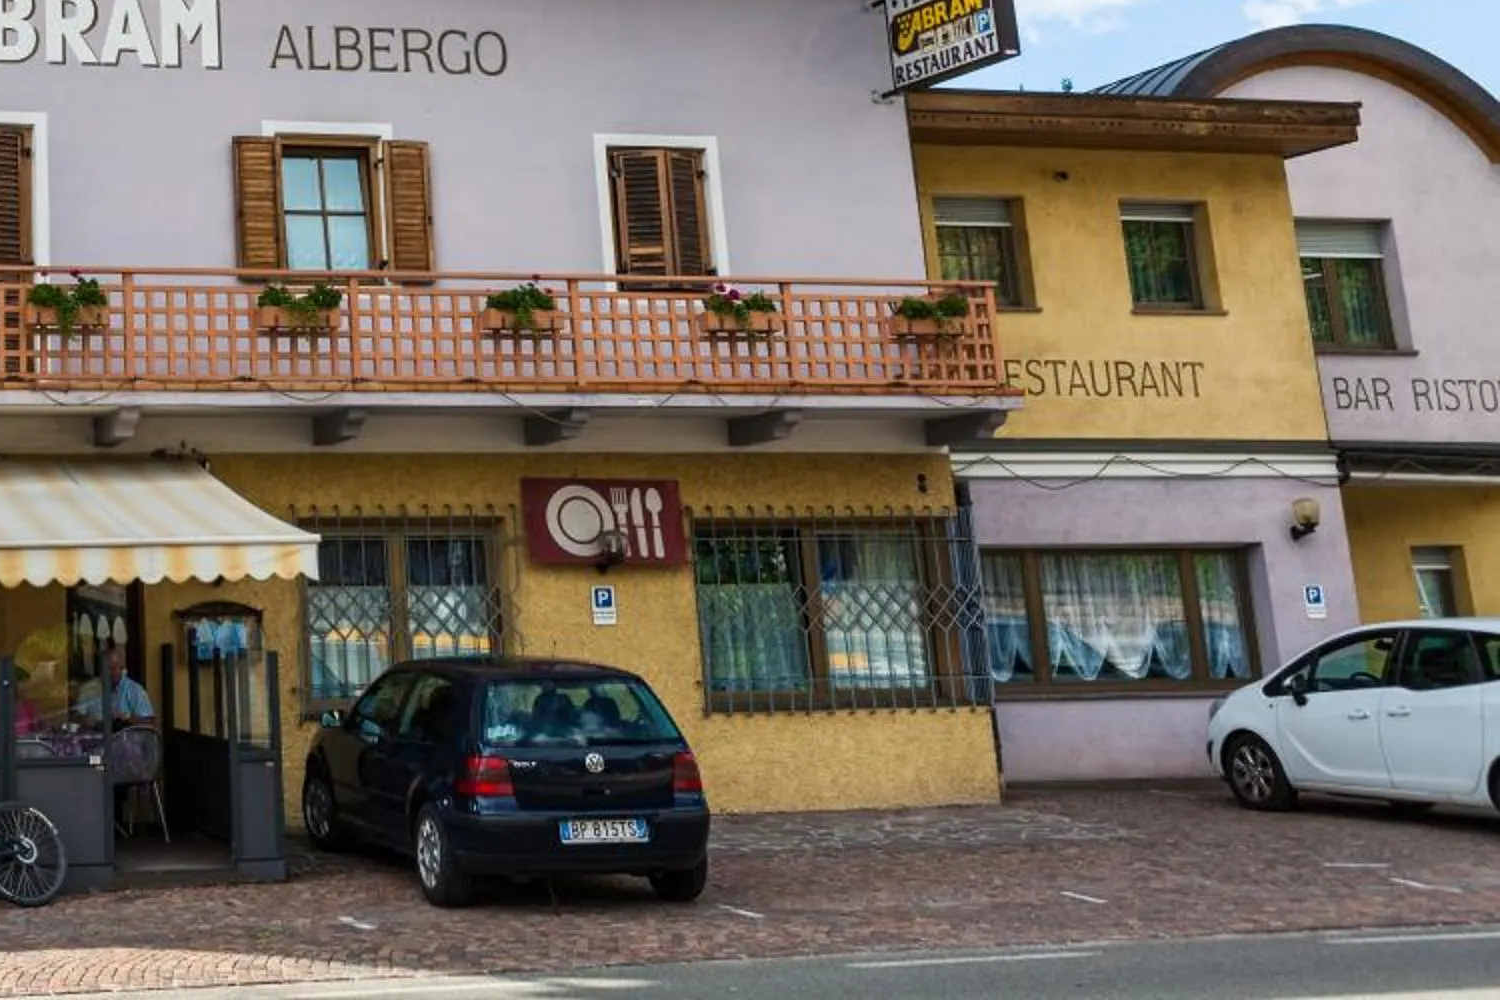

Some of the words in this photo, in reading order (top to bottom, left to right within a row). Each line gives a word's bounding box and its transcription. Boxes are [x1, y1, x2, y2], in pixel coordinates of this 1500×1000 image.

[269, 24, 508, 77] ALBERGO
[895, 32, 996, 85] RESTAURANT
[996, 359, 1205, 399] ESTAURANT
[1333, 376, 1395, 411] BAR
[1411, 378, 1500, 413] RISTO
[598, 591, 609, 606] P
